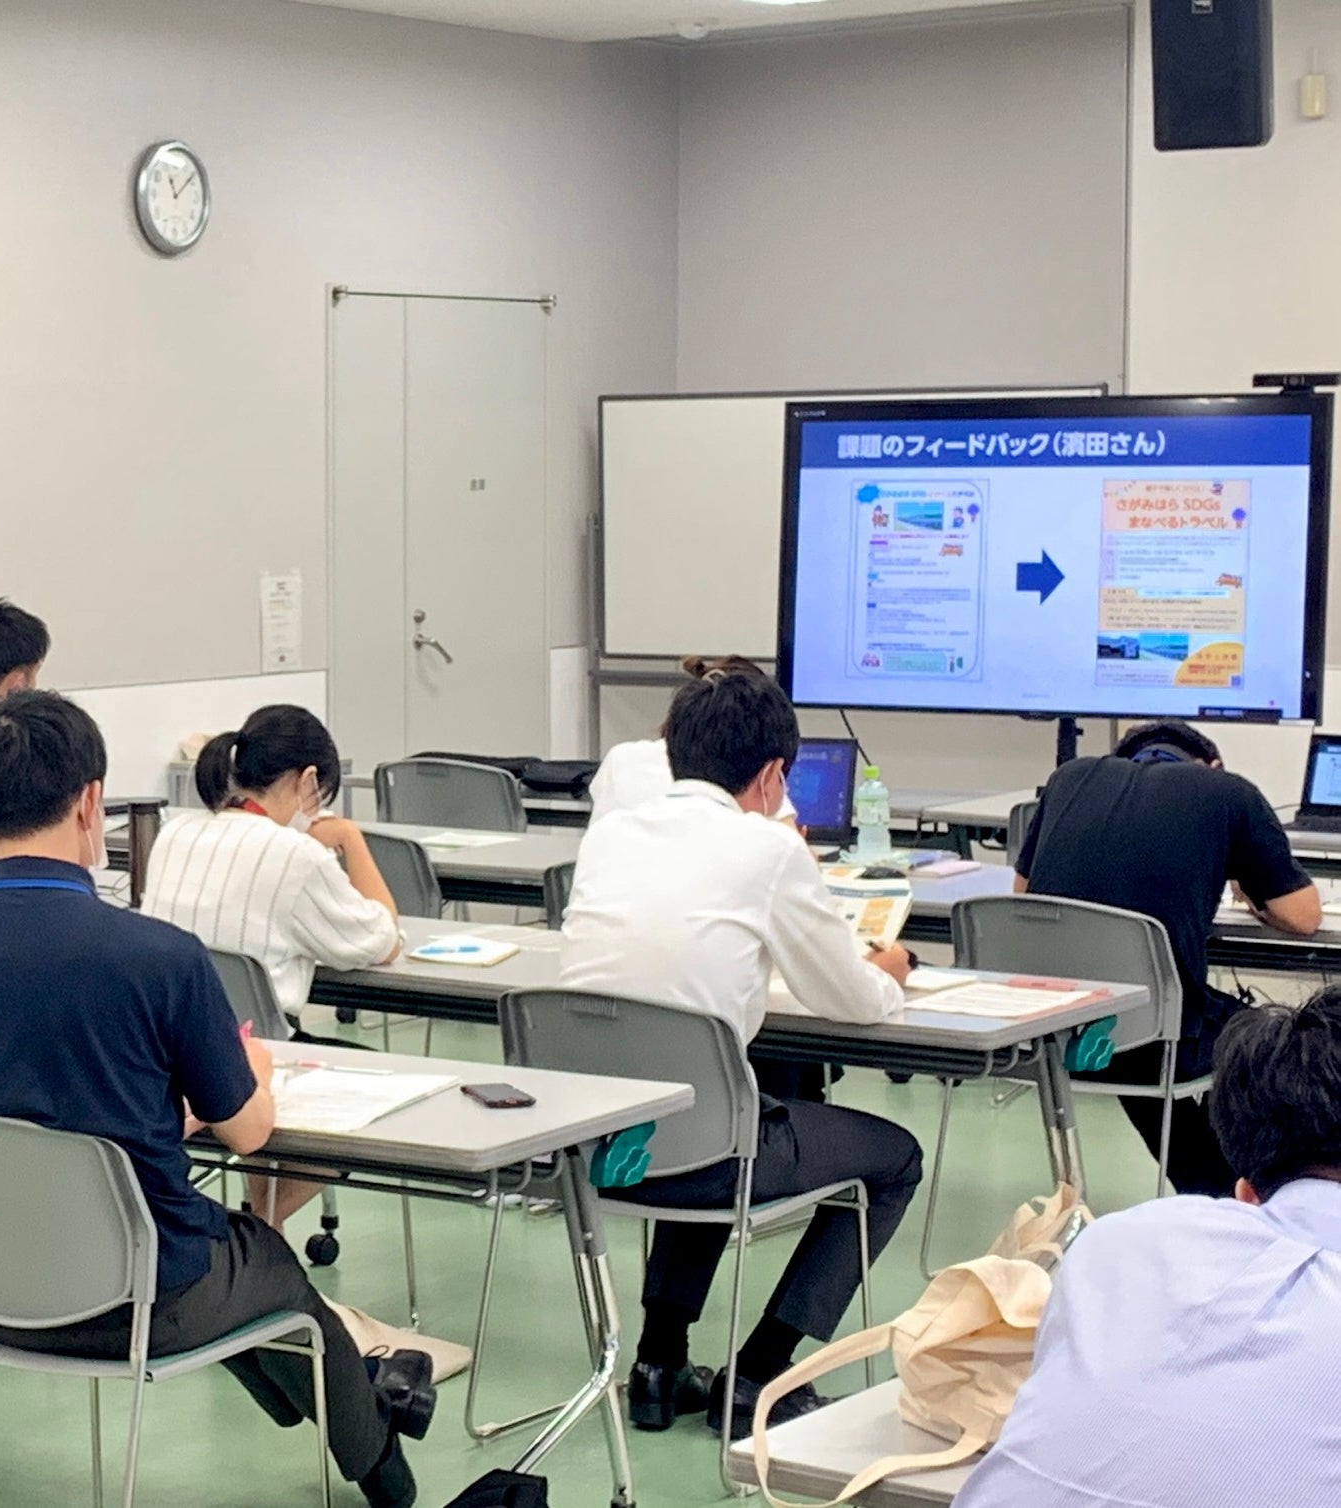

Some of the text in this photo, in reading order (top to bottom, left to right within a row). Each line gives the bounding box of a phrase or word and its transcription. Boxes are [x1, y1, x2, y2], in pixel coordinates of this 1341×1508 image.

[1116, 498, 1221, 511] さがみはら SDGs
